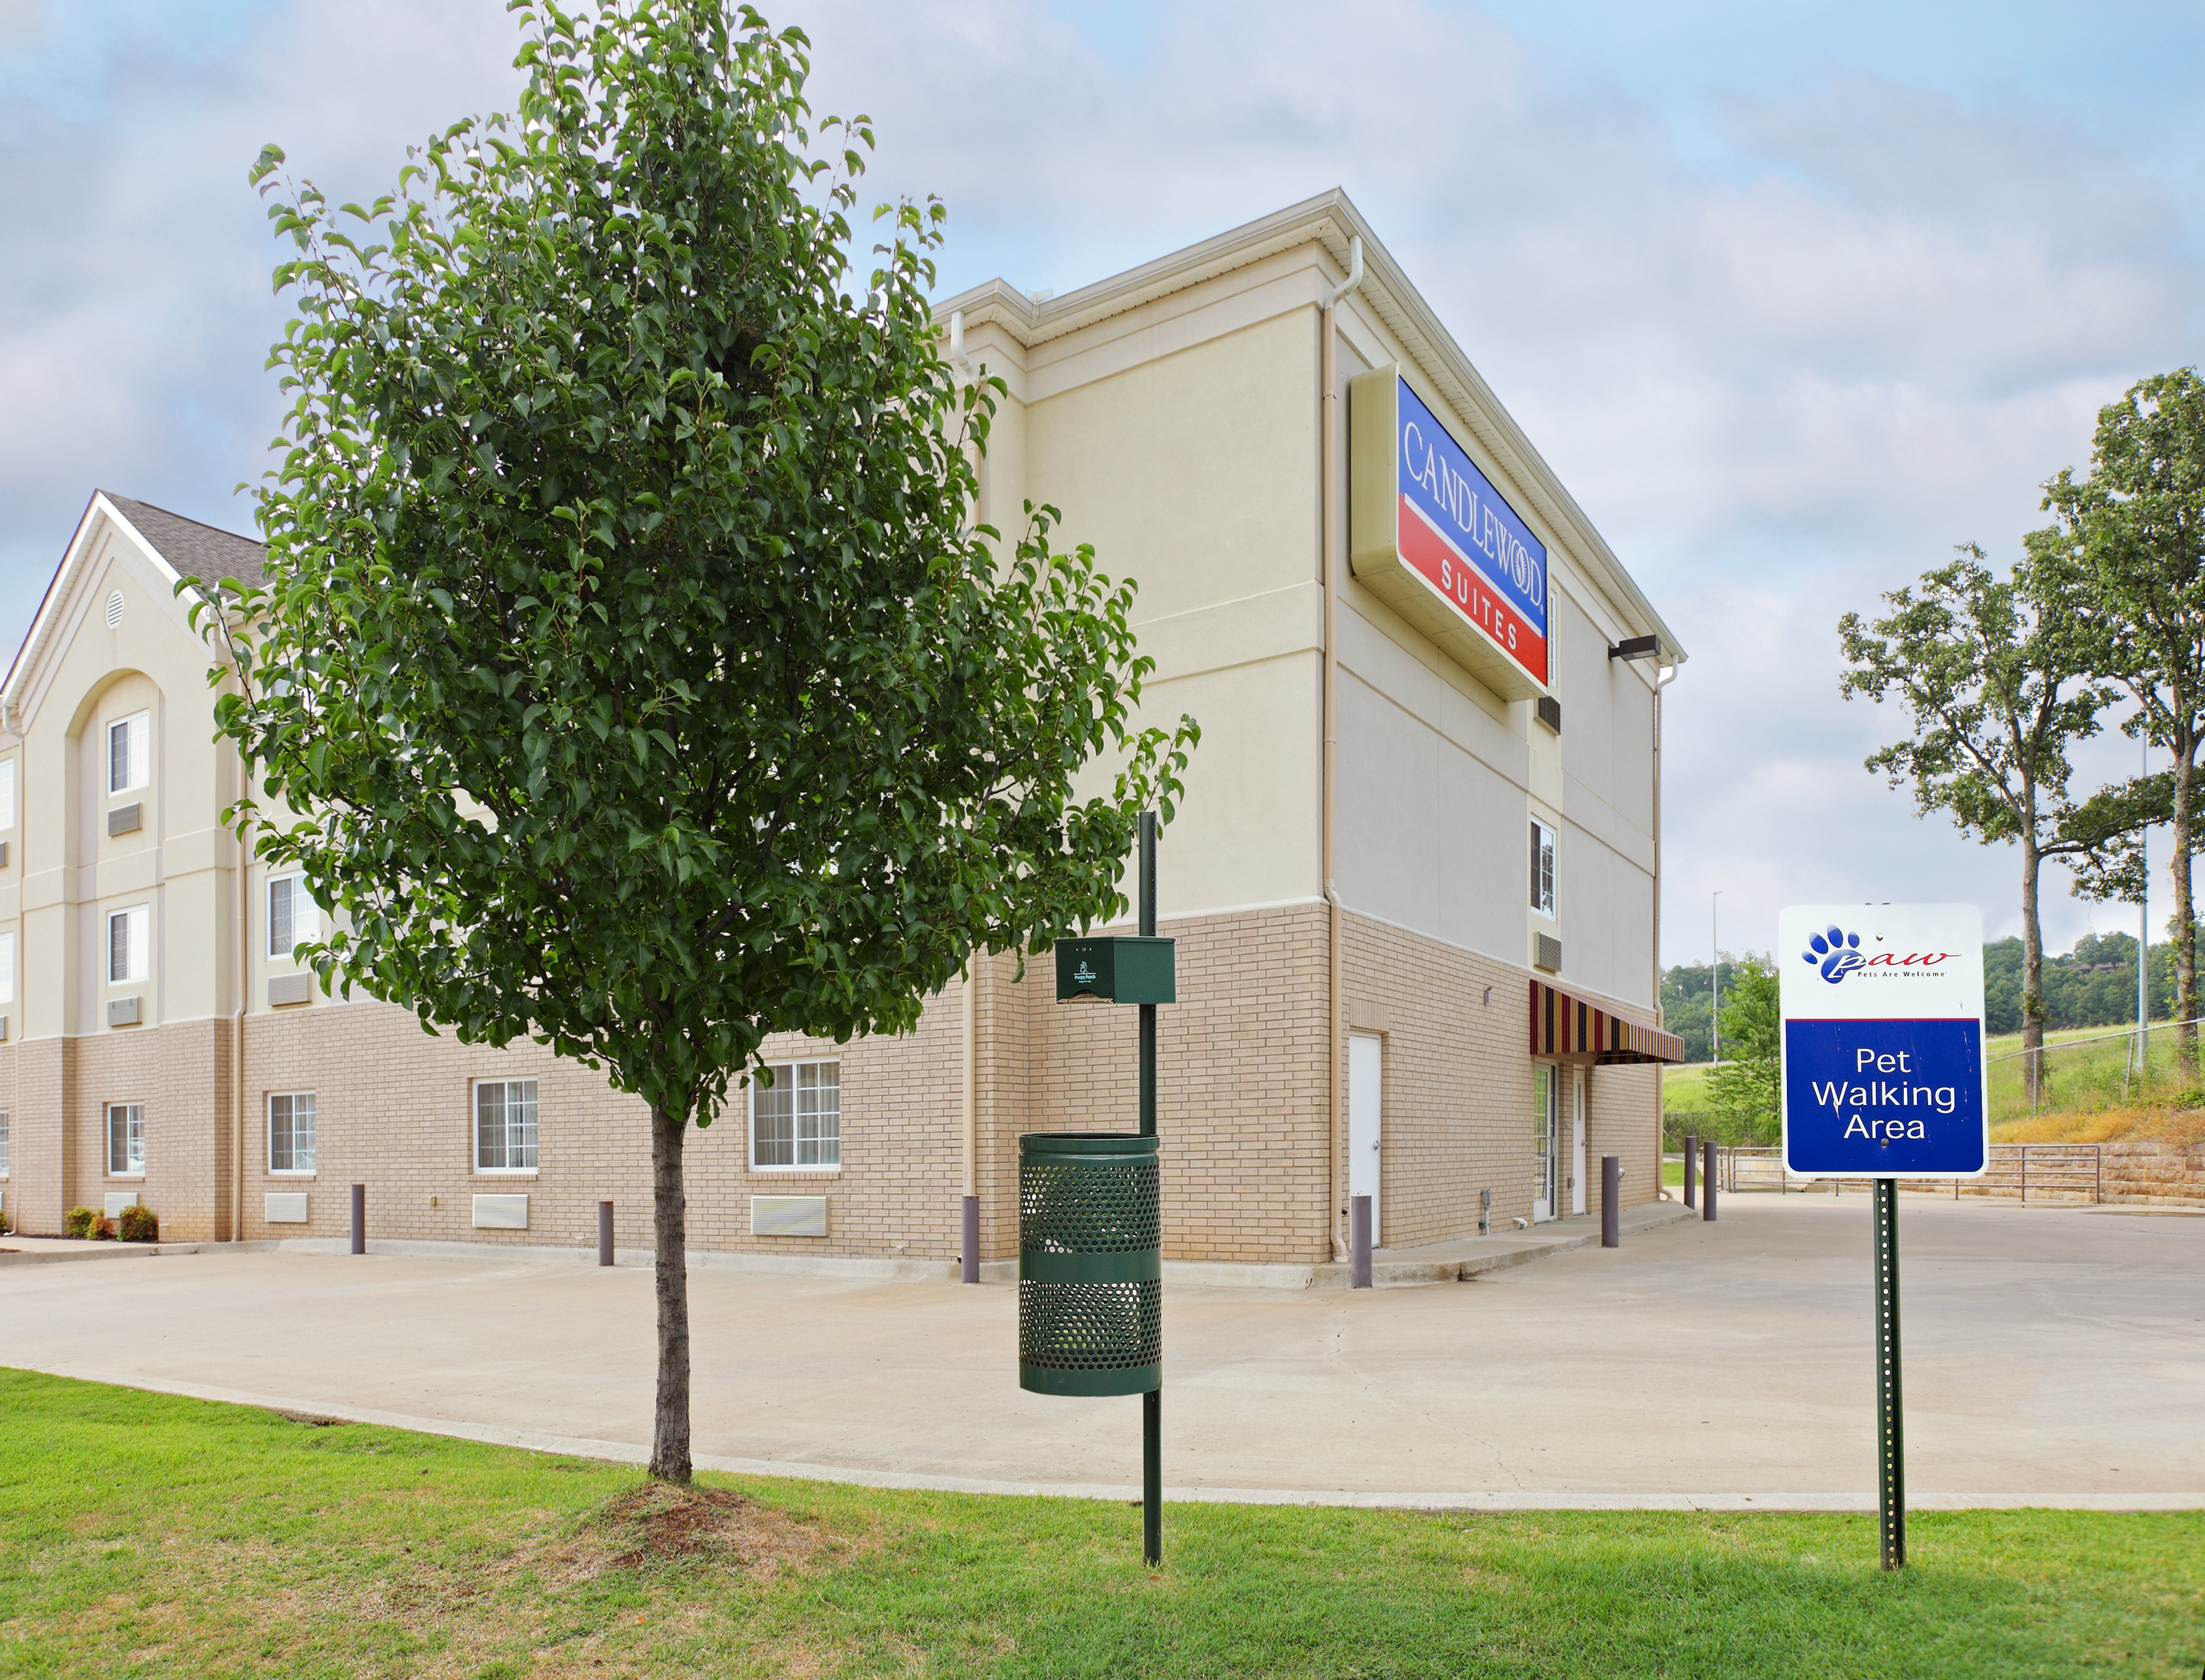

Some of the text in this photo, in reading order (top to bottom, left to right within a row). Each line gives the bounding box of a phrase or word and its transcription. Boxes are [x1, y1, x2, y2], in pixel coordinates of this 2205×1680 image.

[1404, 421, 1542, 606] CANDLEWOOD
[1441, 559, 1517, 650] SUITES
[1827, 953, 1962, 979] paw
[1856, 1048, 1912, 1073] Pet
[1811, 1081, 1956, 1113] Walking
[1843, 1114, 1925, 1139] Area
